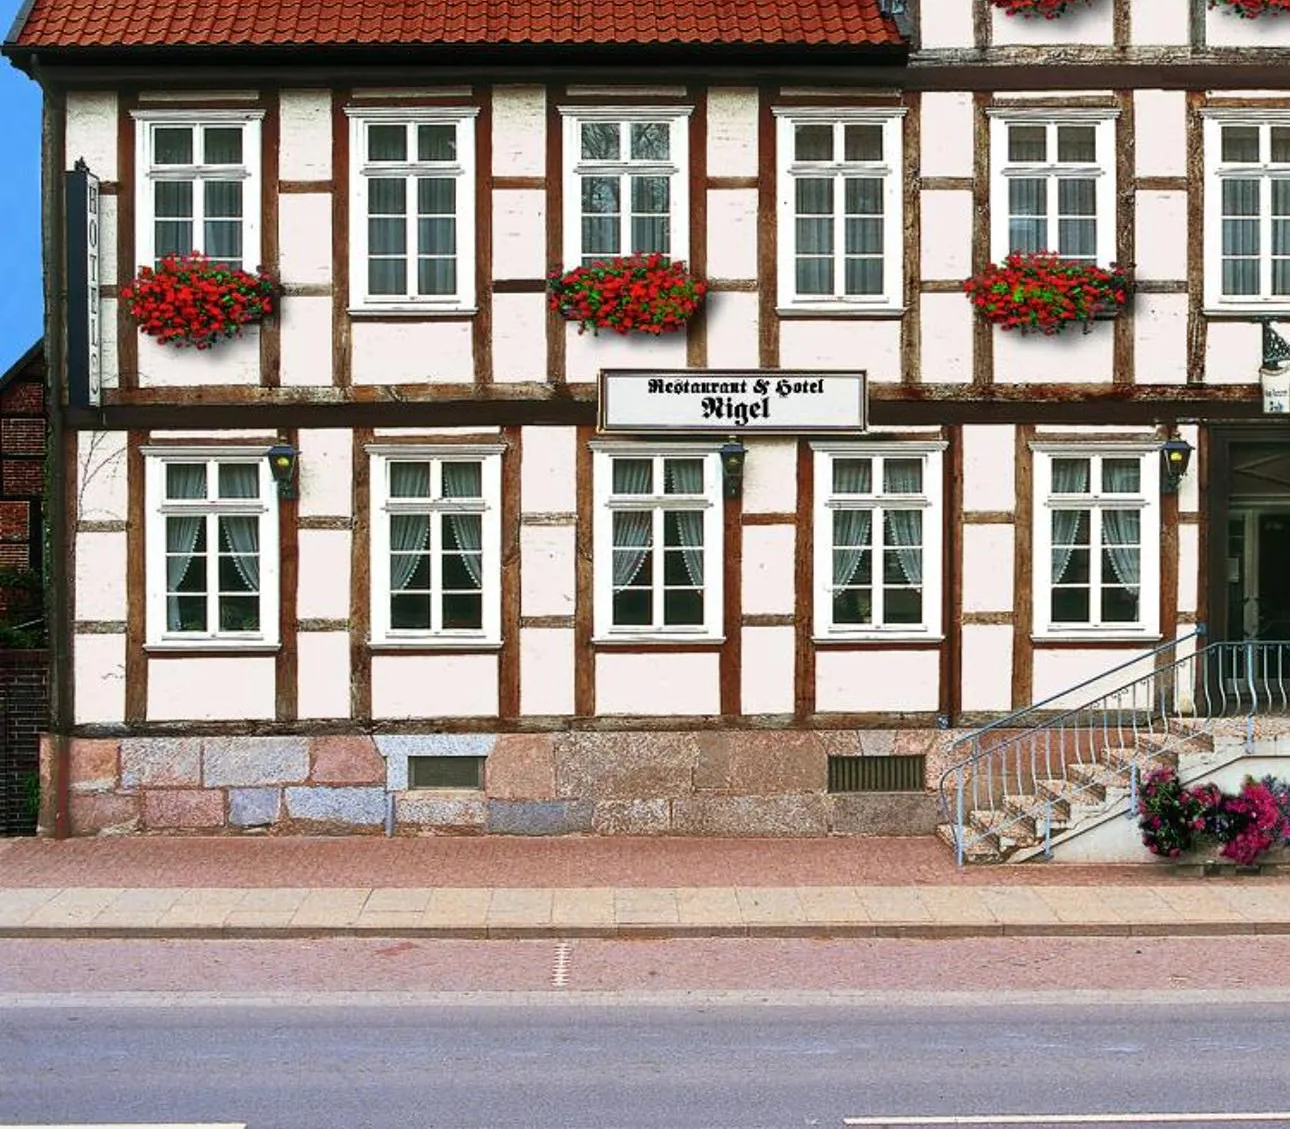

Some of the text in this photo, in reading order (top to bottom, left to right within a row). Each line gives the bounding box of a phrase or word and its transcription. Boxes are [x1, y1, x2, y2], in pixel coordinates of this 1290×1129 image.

[647, 378, 825, 398] Restaurant & Hotel
[700, 397, 770, 426] Nigel
